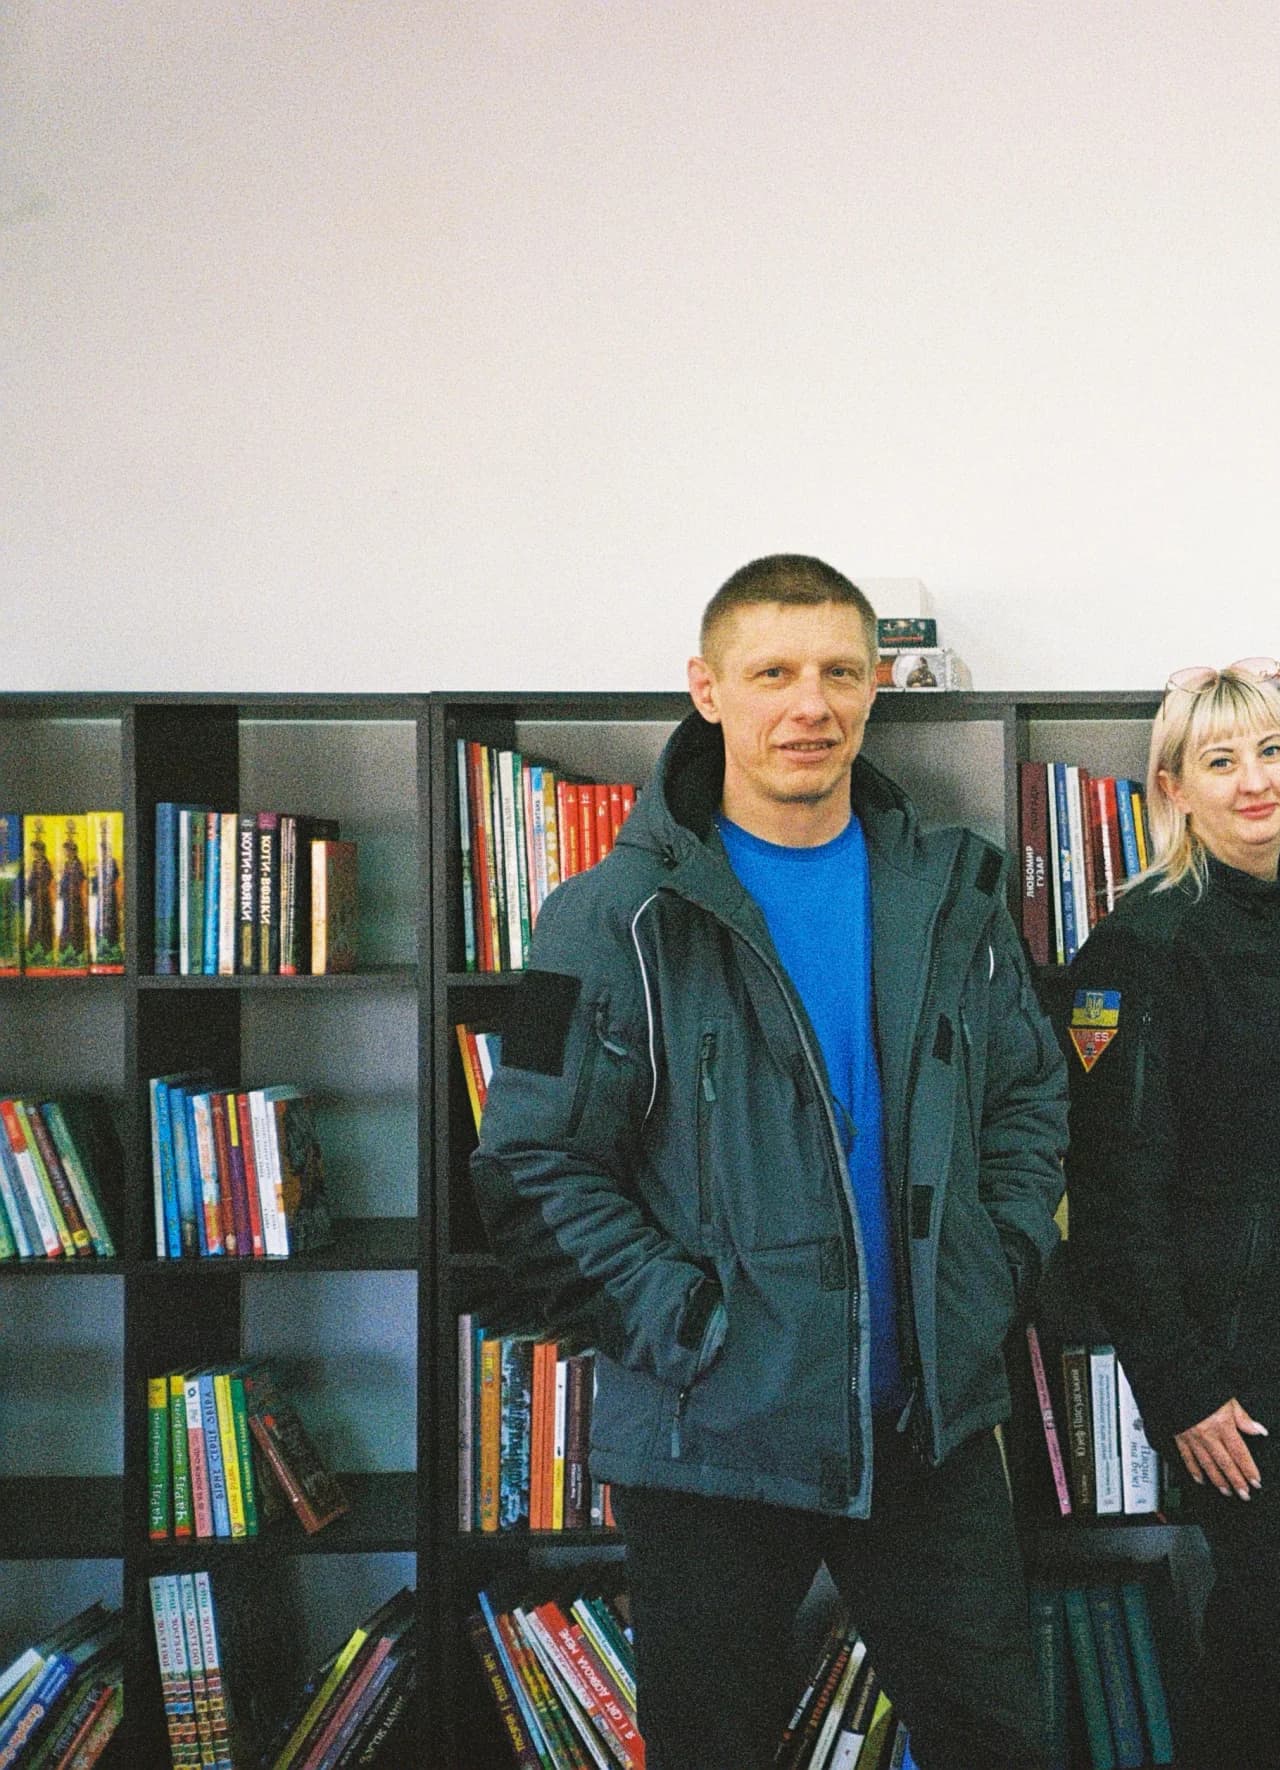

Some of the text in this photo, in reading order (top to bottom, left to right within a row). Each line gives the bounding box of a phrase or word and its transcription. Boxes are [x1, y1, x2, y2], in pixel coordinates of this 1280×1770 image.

[1026, 846, 1034, 897] ЛЮБОМИР
[1036, 856, 1044, 886] ГУЗАР
[1076, 1031, 1109, 1042] MINES
[558, 1627, 581, 1655] МЕНЕ
[576, 1655, 611, 1699] ДОВКОЛА
[603, 1700, 624, 1722] СВІТ
